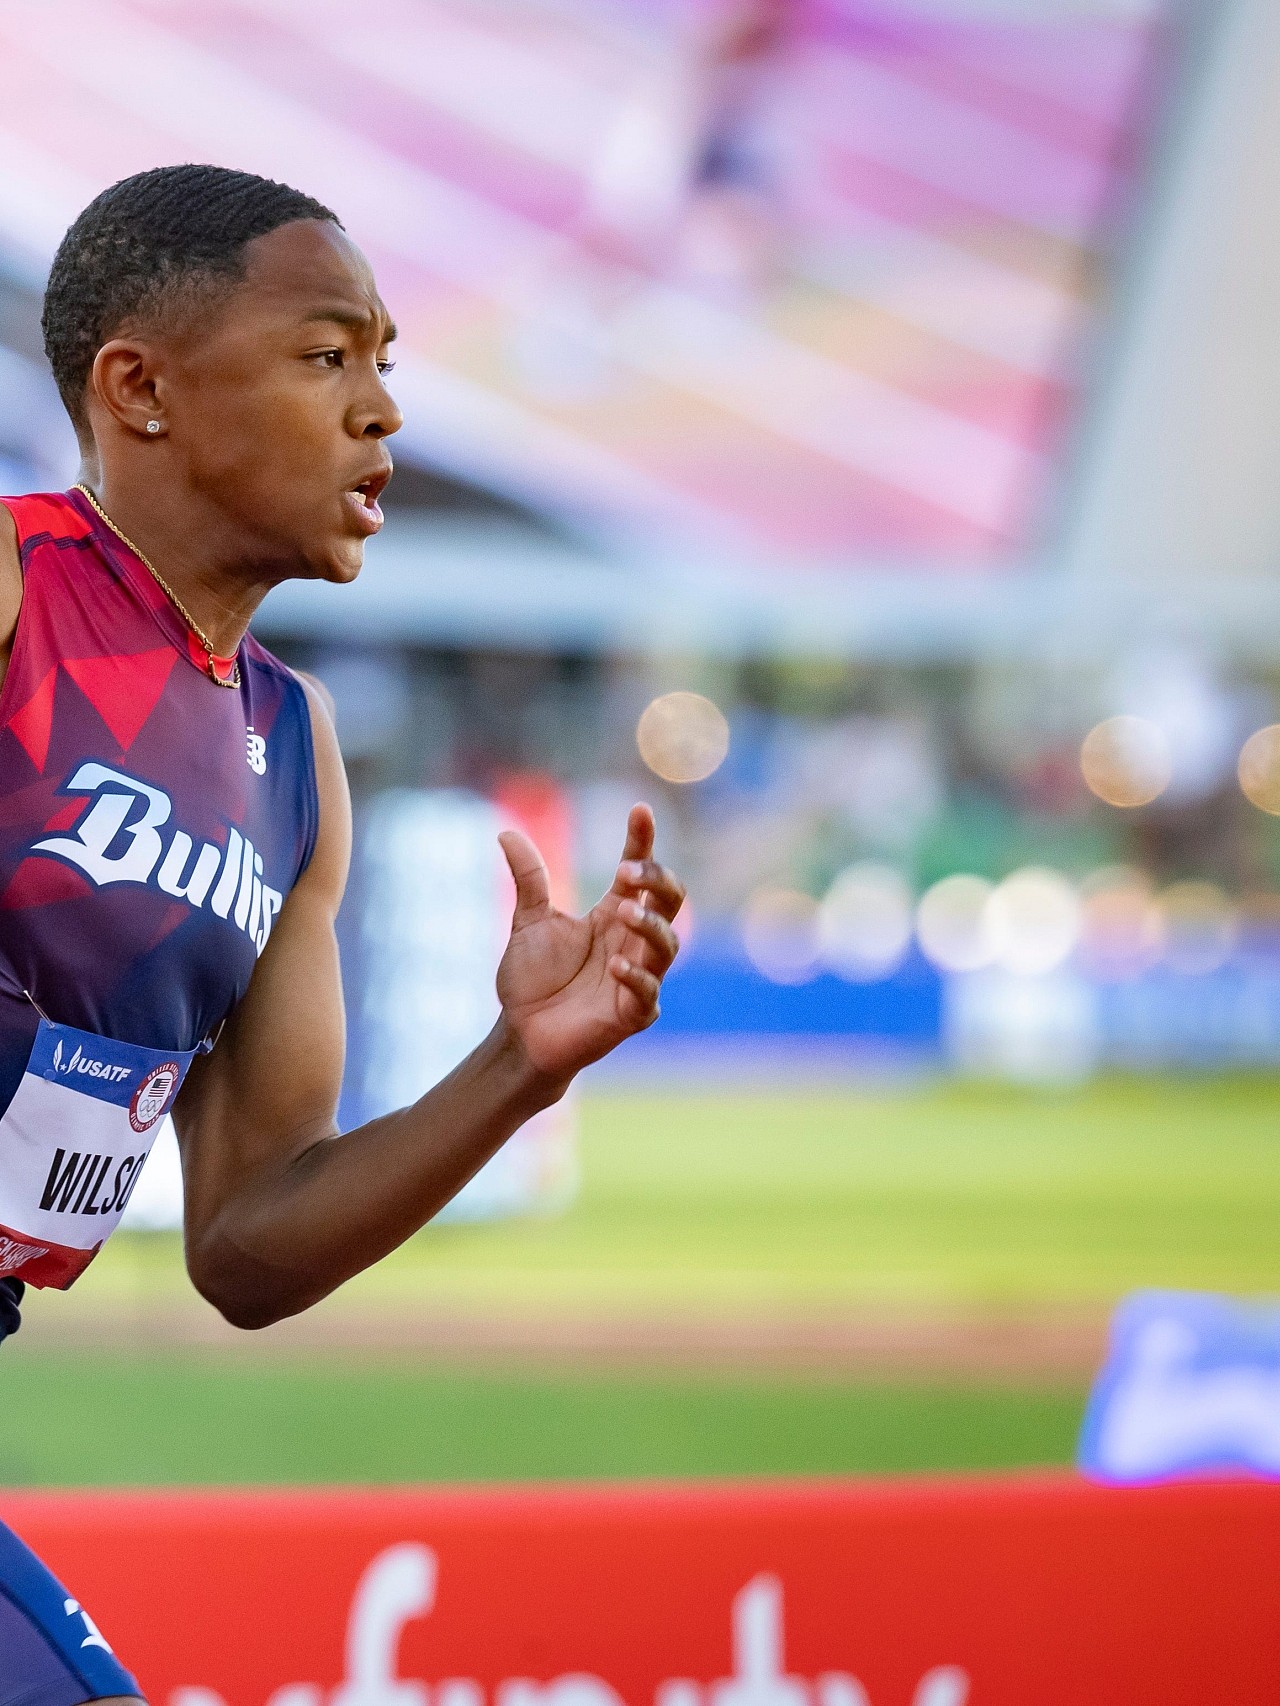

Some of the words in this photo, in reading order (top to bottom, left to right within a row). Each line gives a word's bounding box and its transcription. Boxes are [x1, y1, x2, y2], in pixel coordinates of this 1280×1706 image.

[30, 763, 283, 959] Bullis
[77, 1056, 132, 1082] USATF
[39, 1148, 150, 1215] WILSO
